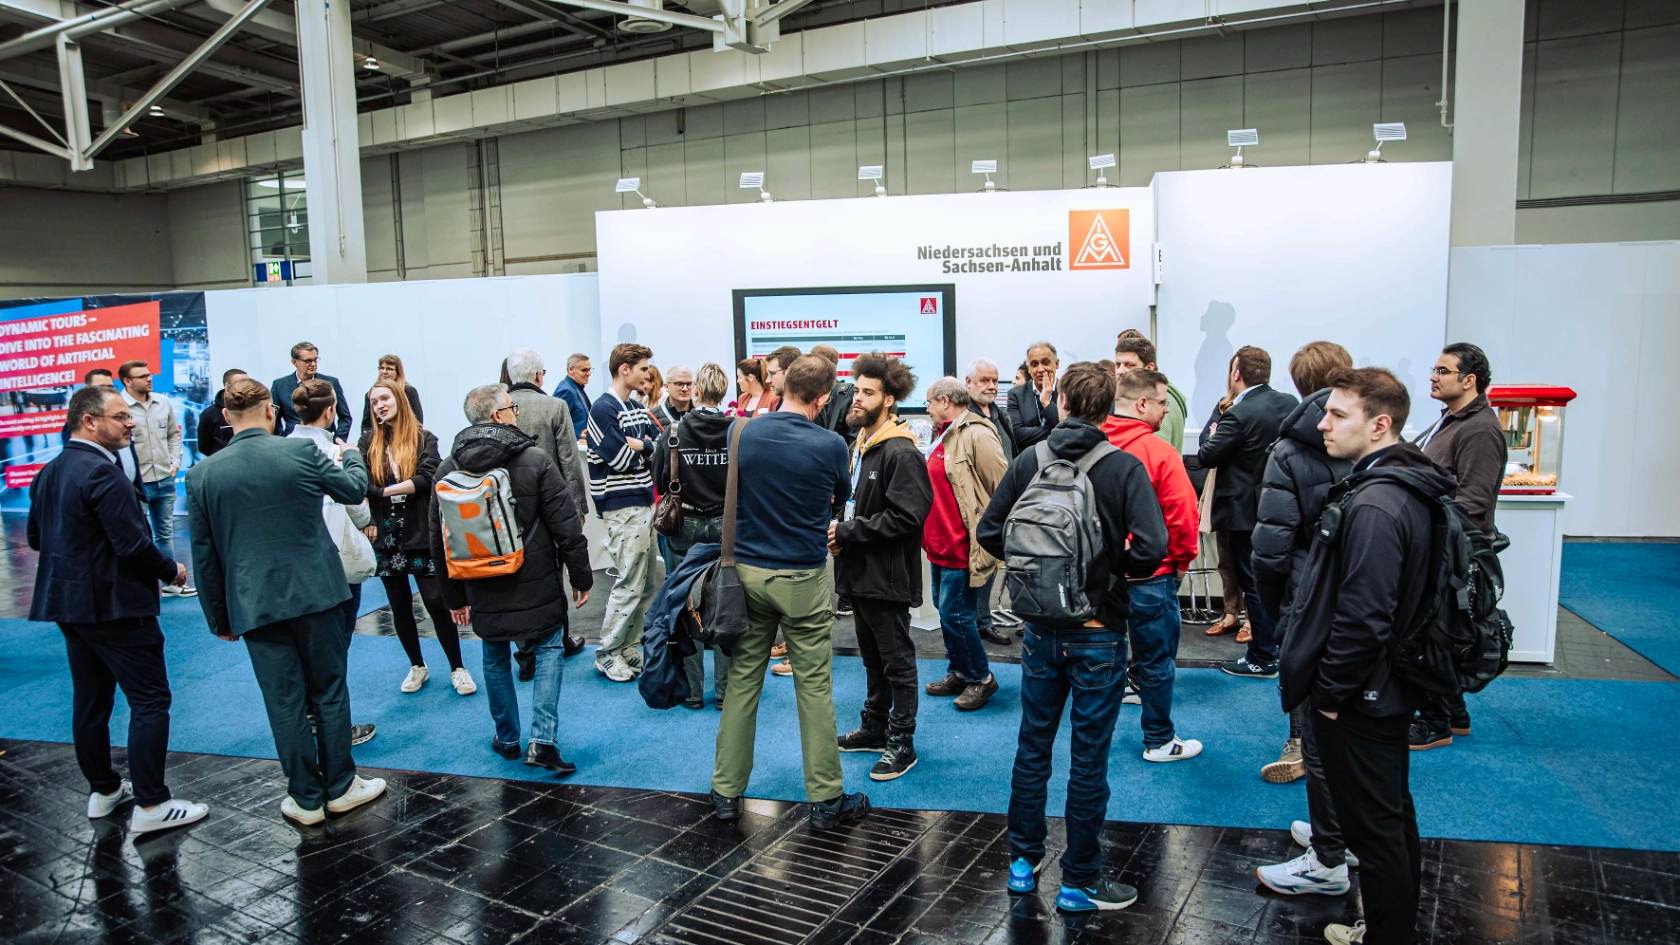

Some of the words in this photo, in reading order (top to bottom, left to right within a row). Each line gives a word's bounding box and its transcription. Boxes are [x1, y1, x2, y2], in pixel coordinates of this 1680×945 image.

[917, 243, 1029, 260] Niedersachsen
[1033, 241, 1062, 256] und
[942, 257, 1062, 274] Sachsen-Anhalt
[0, 319, 49, 337] DYNAMIC
[50, 314, 87, 330] TOURS
[750, 319, 839, 330] EINSTIEGSENTGELT
[0, 341, 23, 355] DIVE
[25, 338, 52, 352] INTO
[53, 335, 75, 348] THE
[76, 324, 150, 345] FASCINATING
[0, 357, 39, 373] WORLD
[40, 355, 56, 367] OF
[57, 347, 116, 366] ARTIFICIAL
[0, 370, 76, 389] INTELLIGENCE!
[681, 452, 730, 465] WETTE
